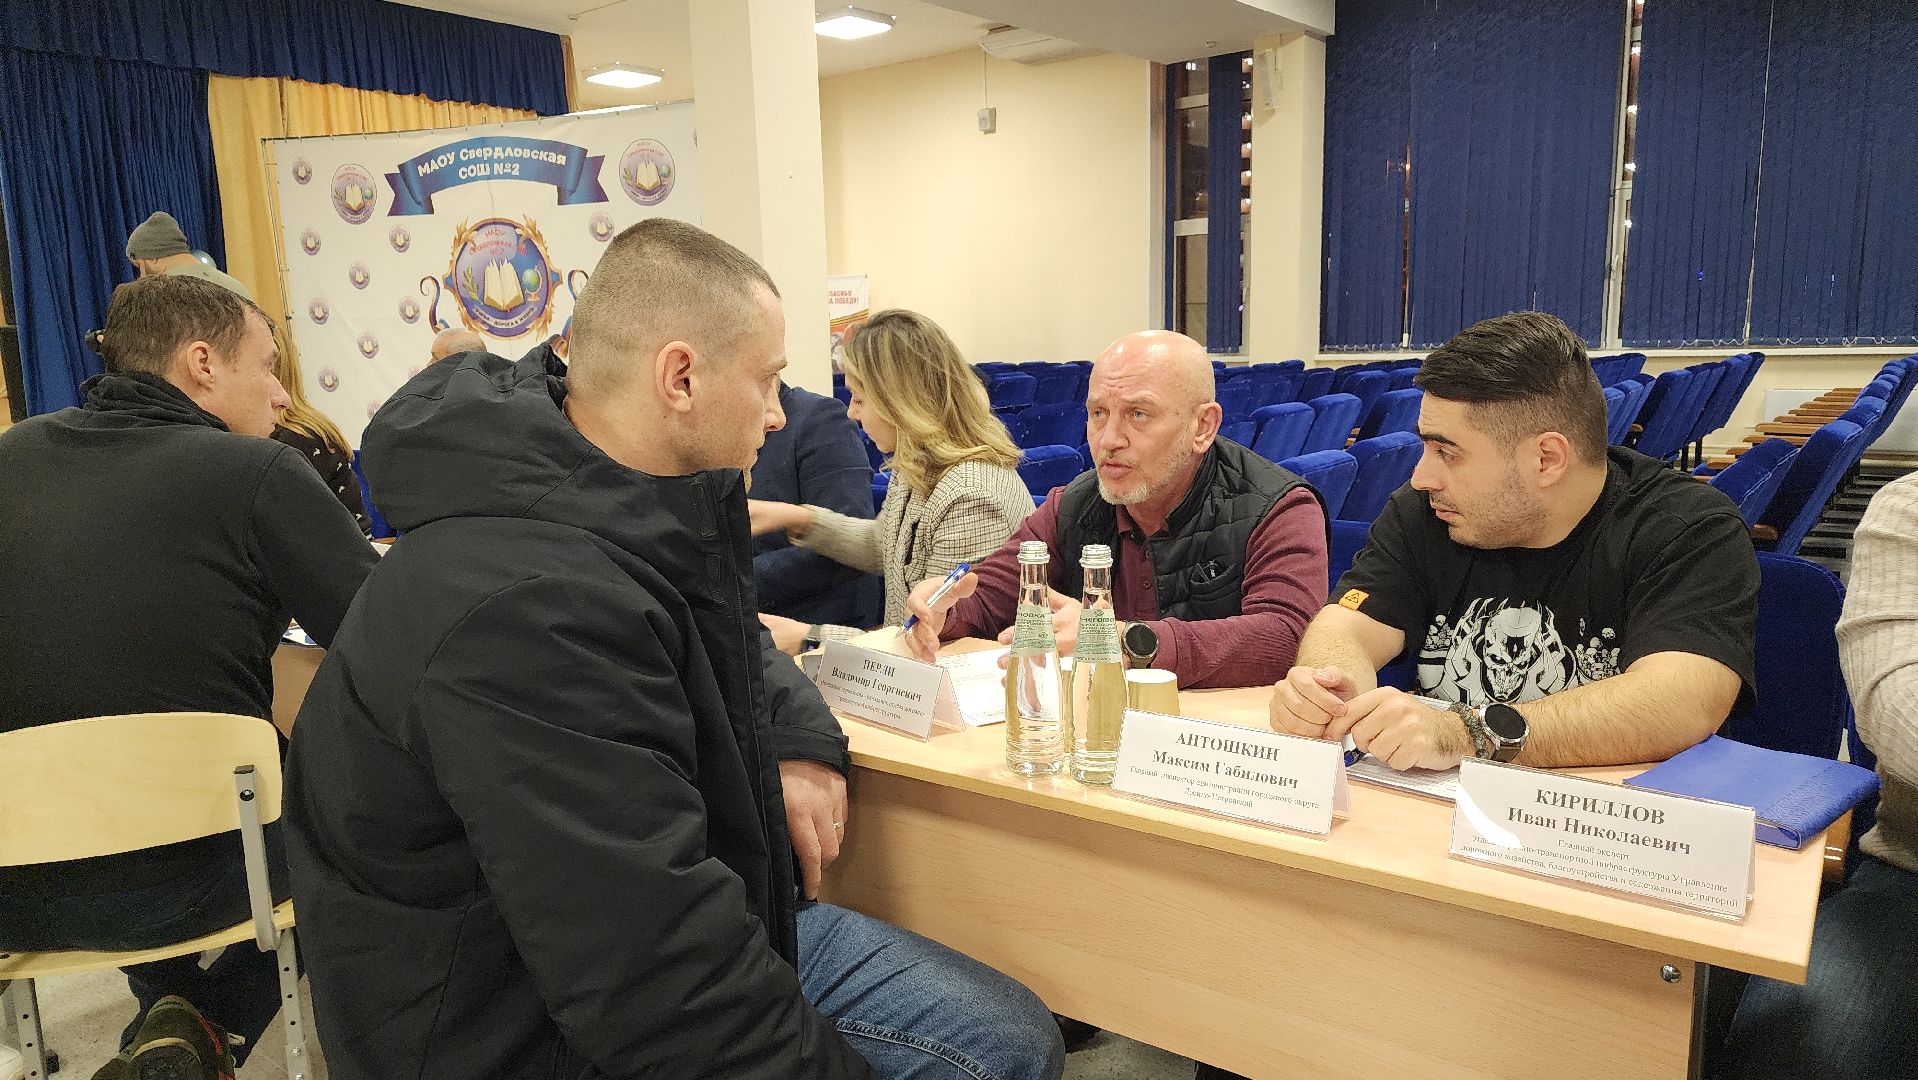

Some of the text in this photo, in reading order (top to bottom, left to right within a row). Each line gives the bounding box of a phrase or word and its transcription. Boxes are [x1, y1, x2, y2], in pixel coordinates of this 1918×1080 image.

[417, 146, 567, 177] МАОУ Свердловская
[458, 162, 520, 180] СОШ №2
[862, 659, 896, 678] ПЕРЛИ
[873, 678, 922, 703] Георгиевич
[1174, 732, 1280, 761] АНТОШКИН
[1152, 750, 1298, 789] Максим Габилович
[1535, 788, 1665, 825] КИРИЛЛОВ
[1507, 806, 1691, 854] Иван Николаевич
